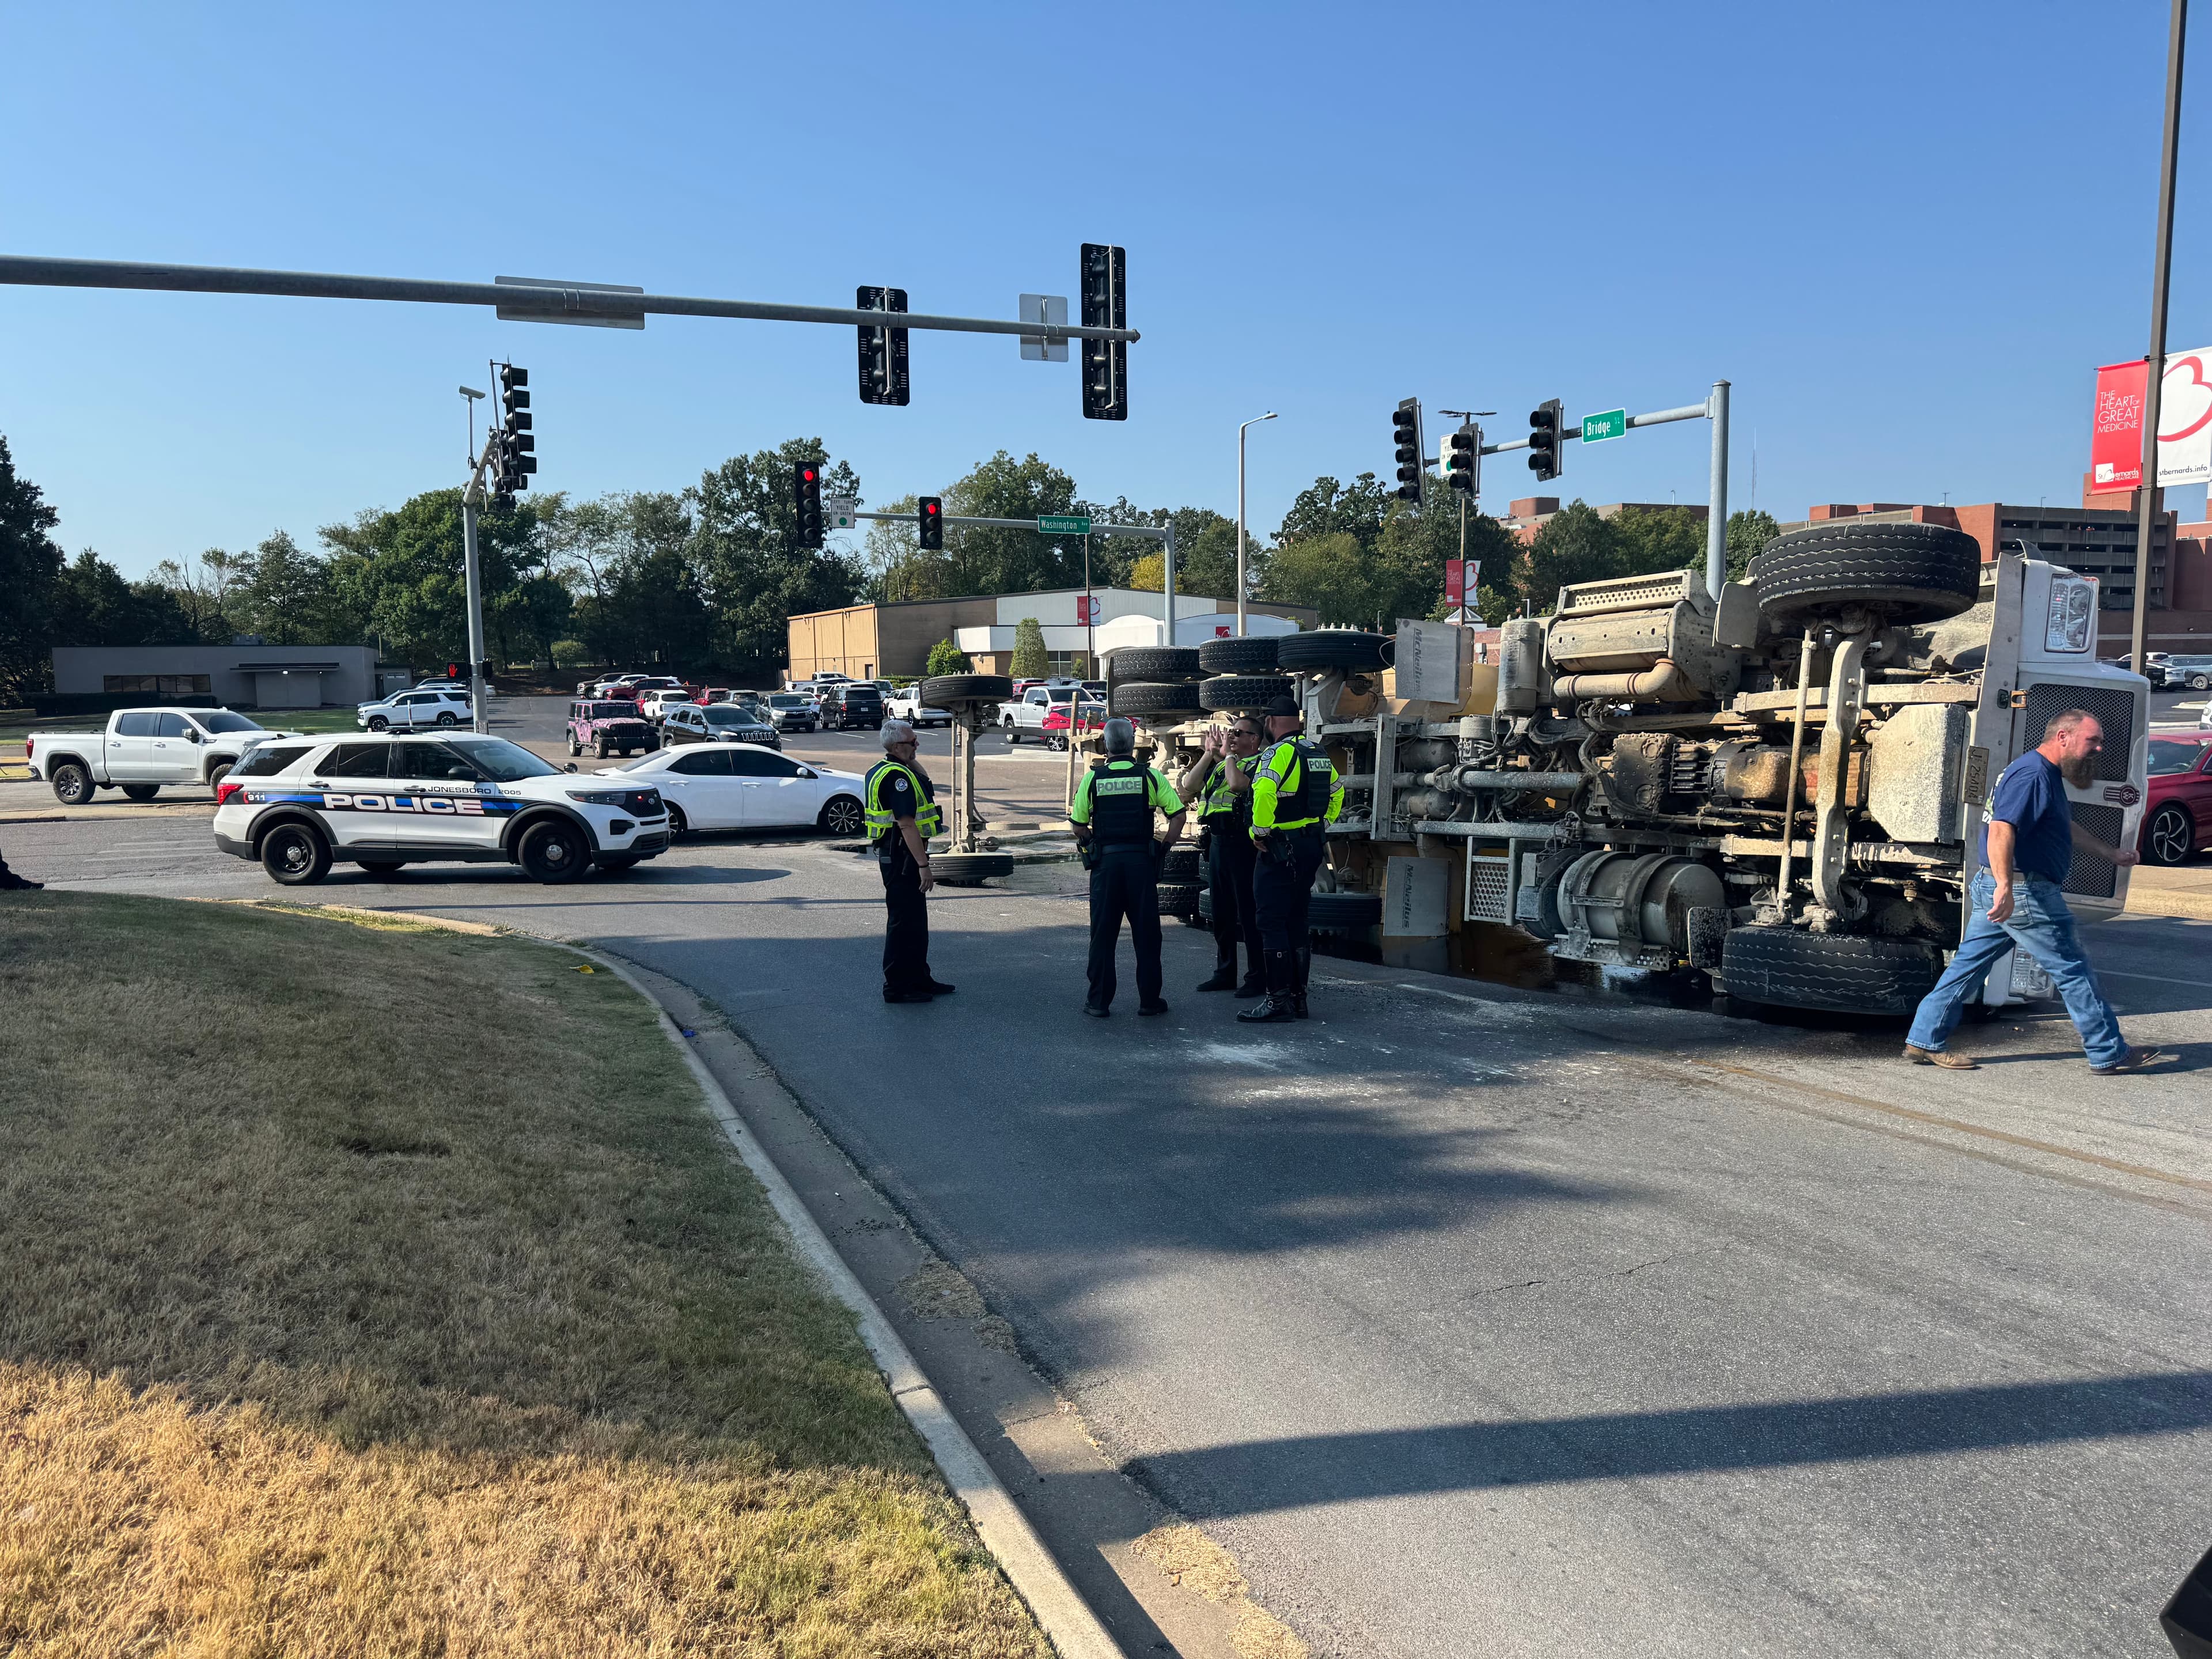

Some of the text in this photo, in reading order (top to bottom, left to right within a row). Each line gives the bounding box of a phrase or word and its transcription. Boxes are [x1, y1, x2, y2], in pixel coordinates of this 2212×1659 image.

[2100, 390, 2116, 400] THE
[2100, 395, 2135, 411] HEART
[2098, 406, 2140, 424] GREAT
[1587, 421, 1611, 437] Bridge
[2097, 419, 2138, 434] MEDICINE
[2159, 464, 2207, 476] stbernards.info
[1041, 520, 1077, 532] Washington
[1309, 760, 1331, 769] POLICE
[427, 785, 491, 794] JONESBORO
[1097, 781, 1141, 792] POLICE
[323, 793, 485, 815] POLICE
